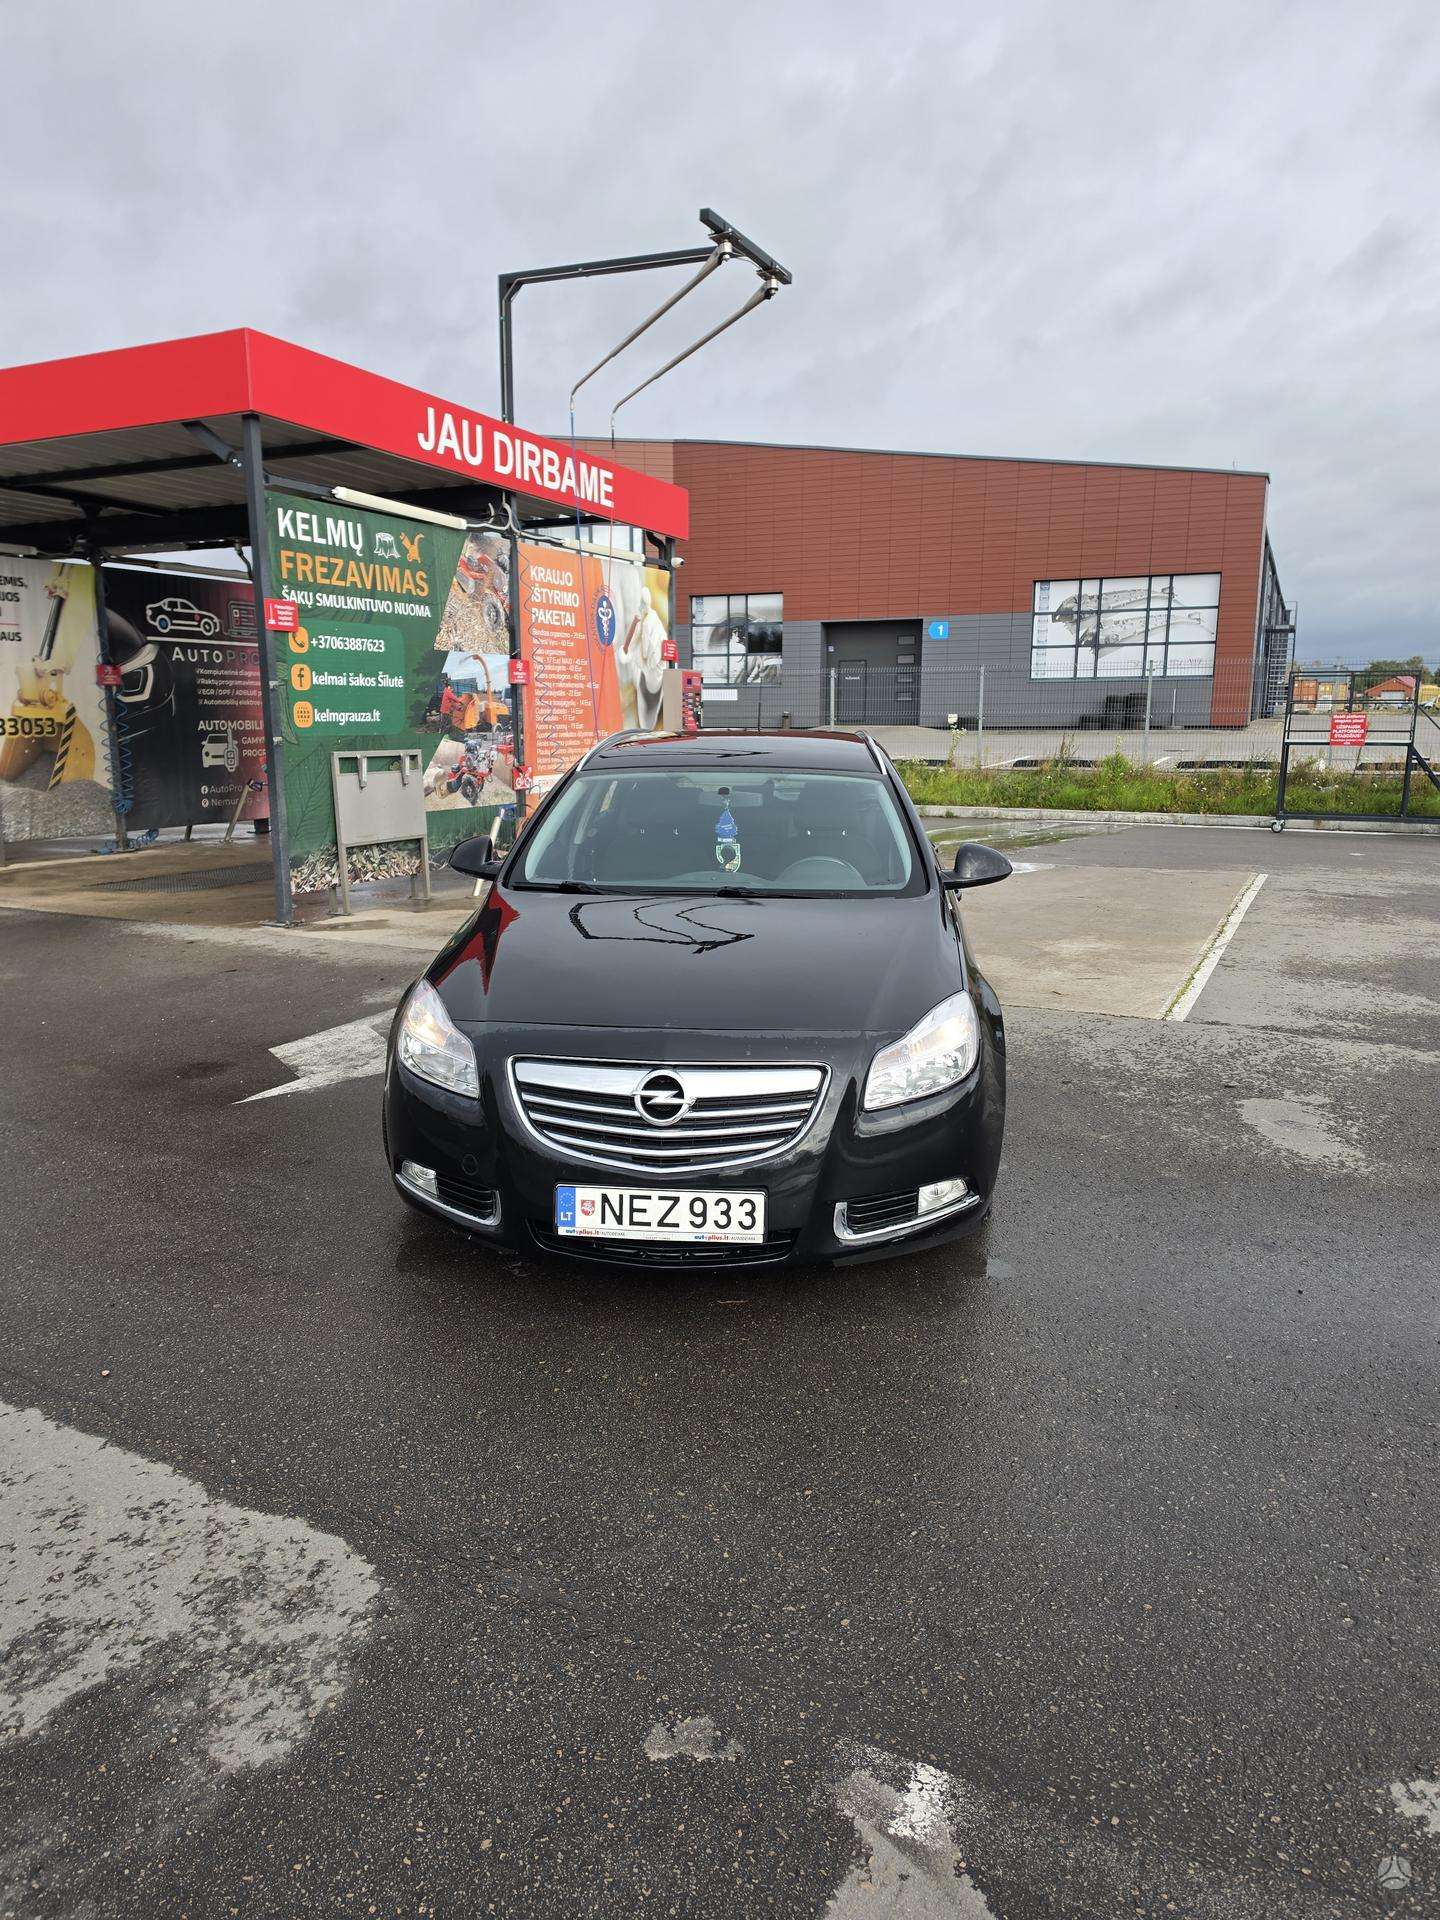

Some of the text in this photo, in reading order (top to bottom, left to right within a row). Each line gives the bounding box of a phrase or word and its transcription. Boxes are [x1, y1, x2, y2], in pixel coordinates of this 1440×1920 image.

[417, 406, 614, 508] JAU DIRBAME
[277, 507, 363, 557] KELMŲ
[280, 550, 430, 597] FREZAVIMAS
[530, 565, 574, 587] KRAUJO
[282, 585, 431, 618] ŠAKŲ SMULKINTUVO NUOMA
[531, 608, 576, 627] PAKETAI
[938, 624, 944, 636] 1
[310, 634, 385, 652] +37063887623
[312, 670, 405, 688] kelmai šakos Šilutė
[314, 708, 382, 726] kelmgrauza.lt
[560, 1211, 573, 1222] LT
